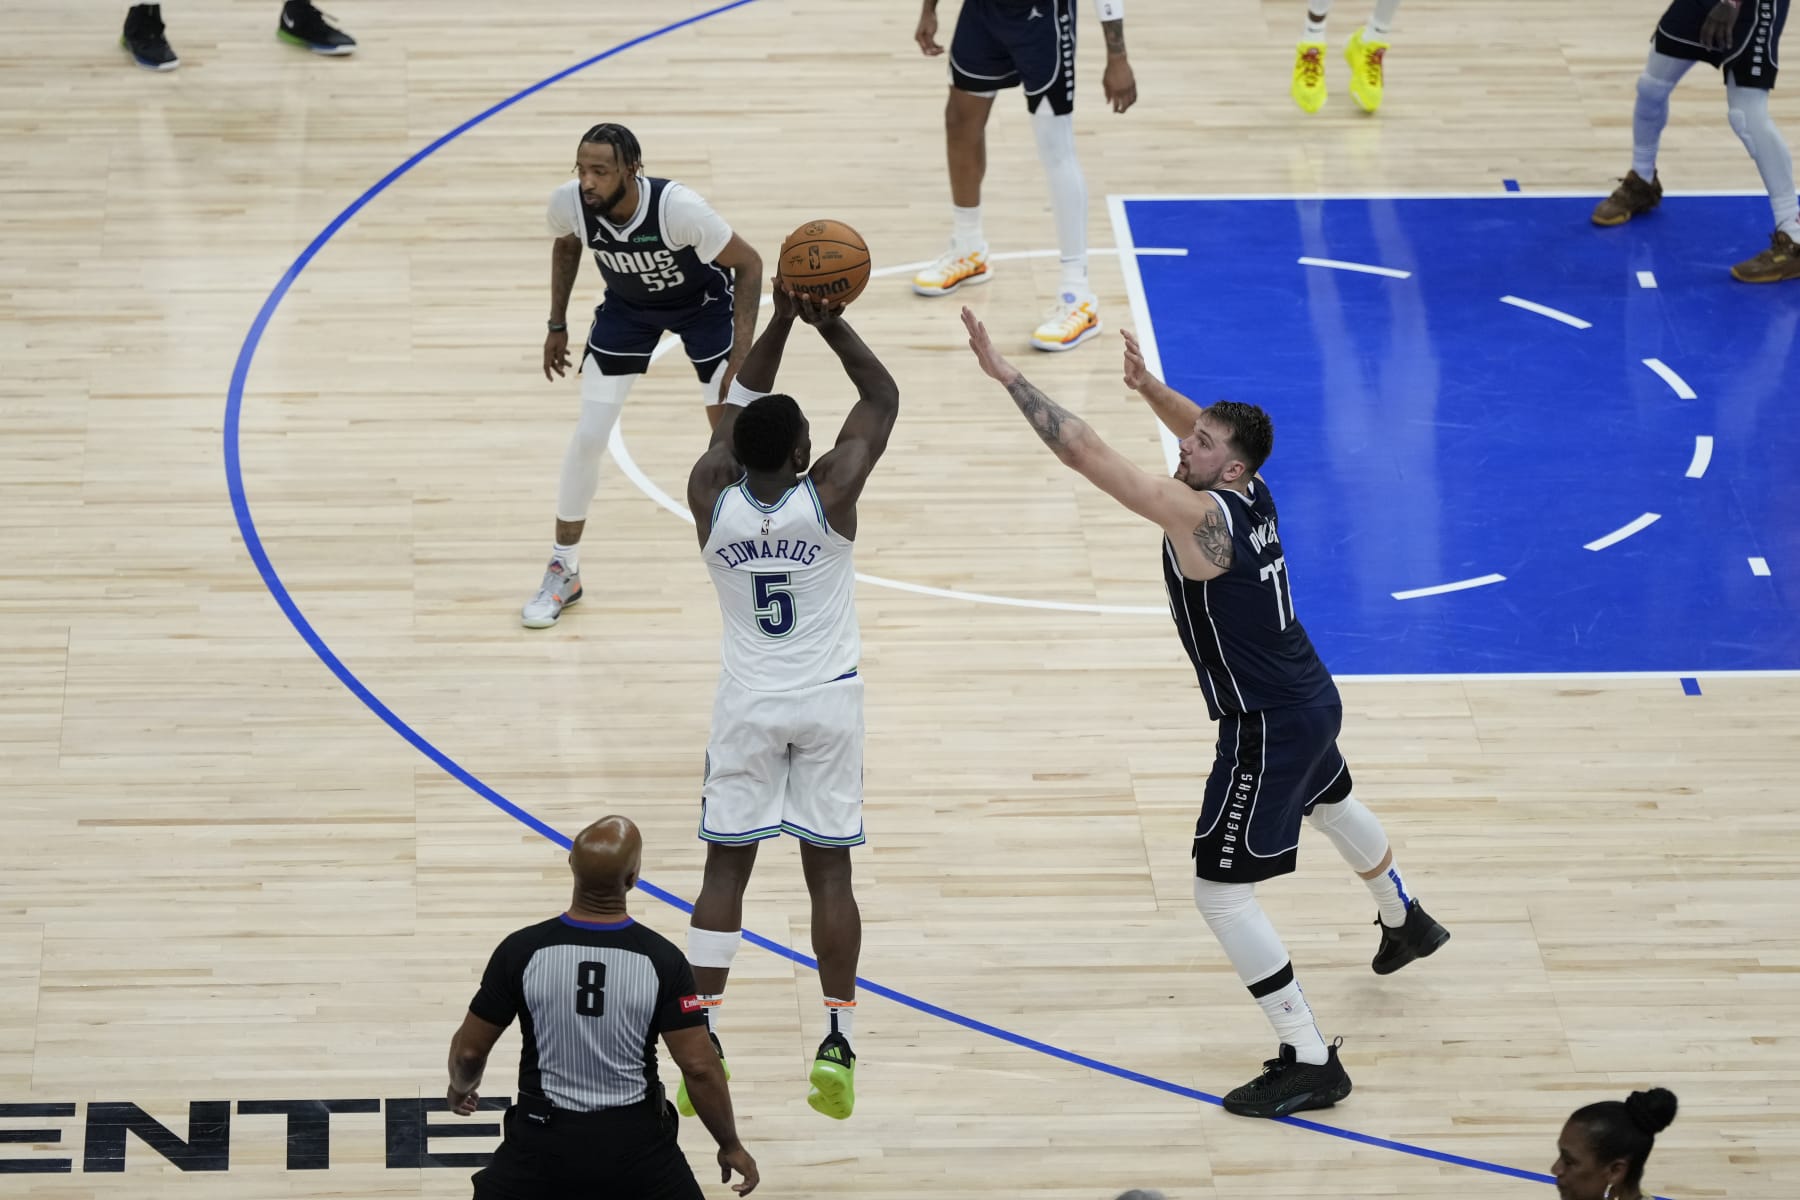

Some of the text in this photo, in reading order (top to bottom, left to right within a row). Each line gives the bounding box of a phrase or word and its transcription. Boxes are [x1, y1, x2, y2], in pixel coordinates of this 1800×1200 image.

[640, 265, 685, 292] 55
[715, 539, 822, 569] EDWARDS
[751, 571, 797, 639] 5
[1219, 773, 1253, 869] MAVERICKS
[576, 961, 606, 1018] 8
